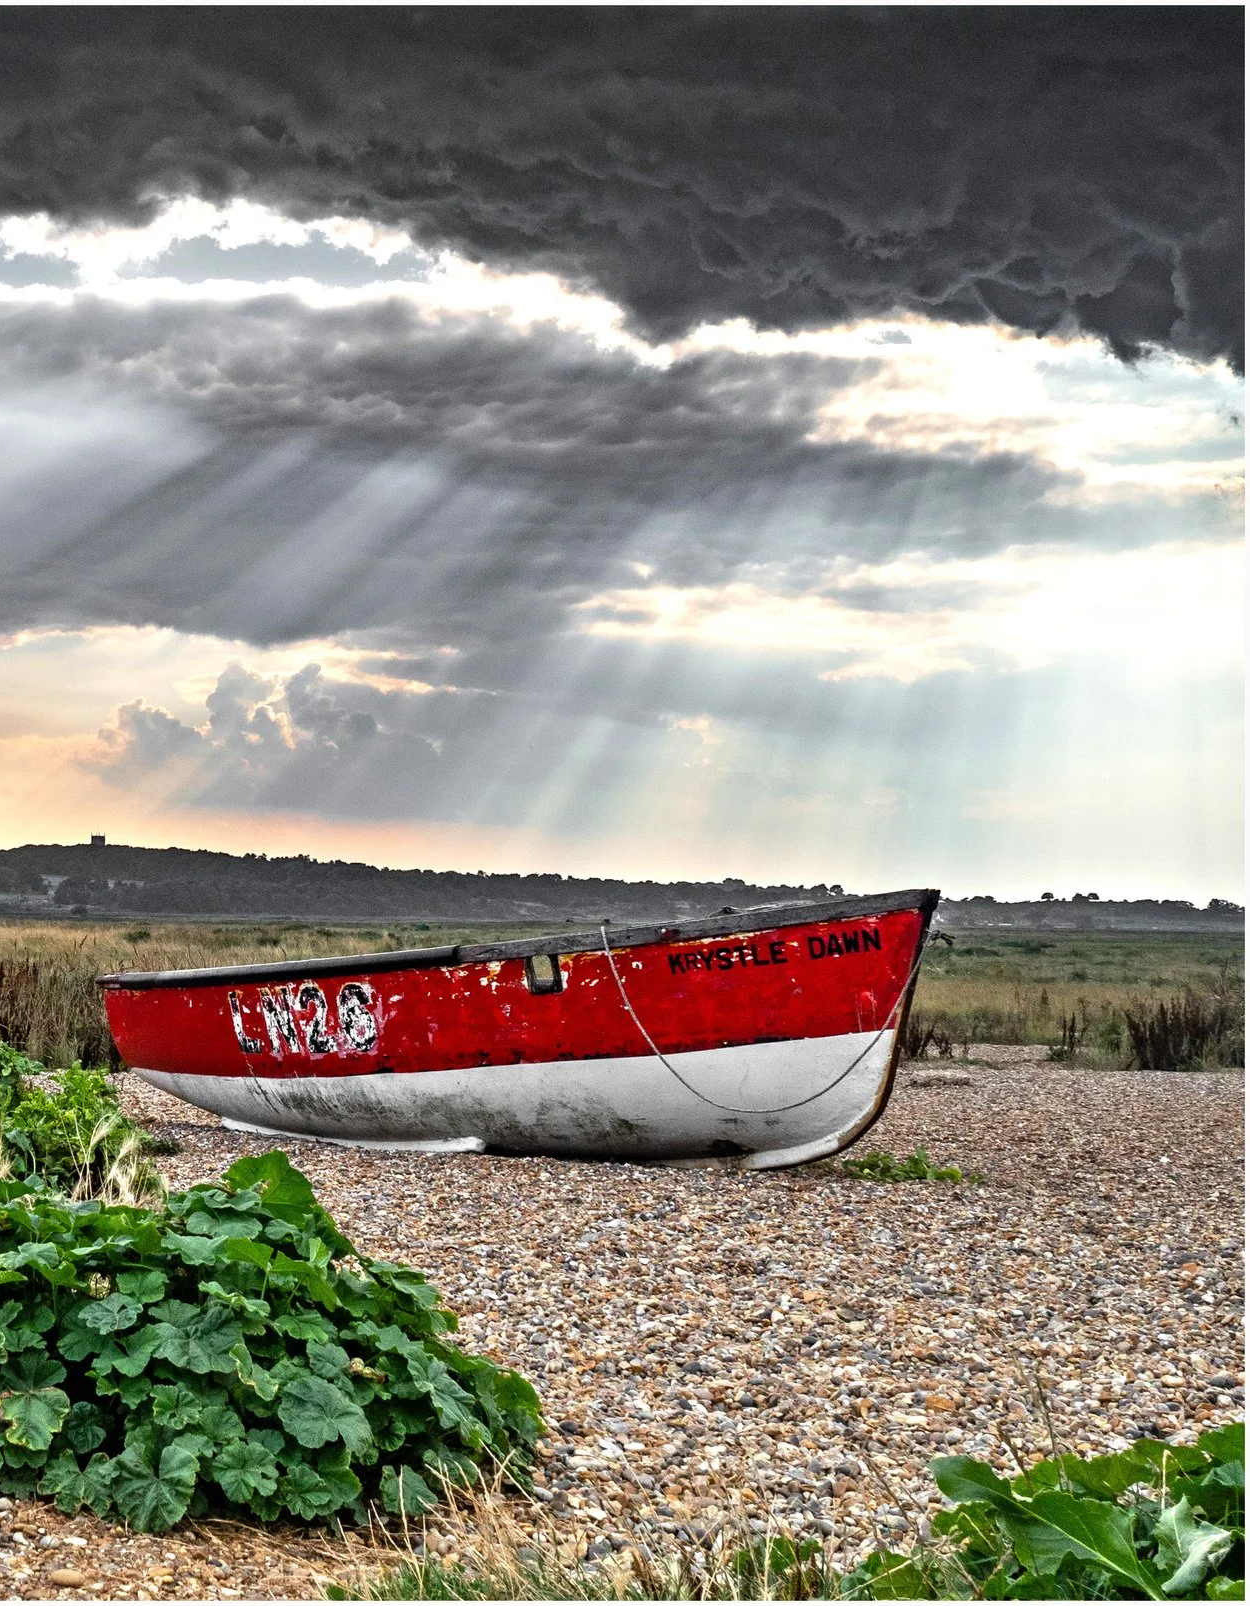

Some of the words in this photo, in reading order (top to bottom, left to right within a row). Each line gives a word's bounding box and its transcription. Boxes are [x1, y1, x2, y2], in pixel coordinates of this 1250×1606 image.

[668, 941, 788, 975] KRYSTLE
[807, 928, 882, 960] DAWN
[228, 982, 377, 1054] LN26
